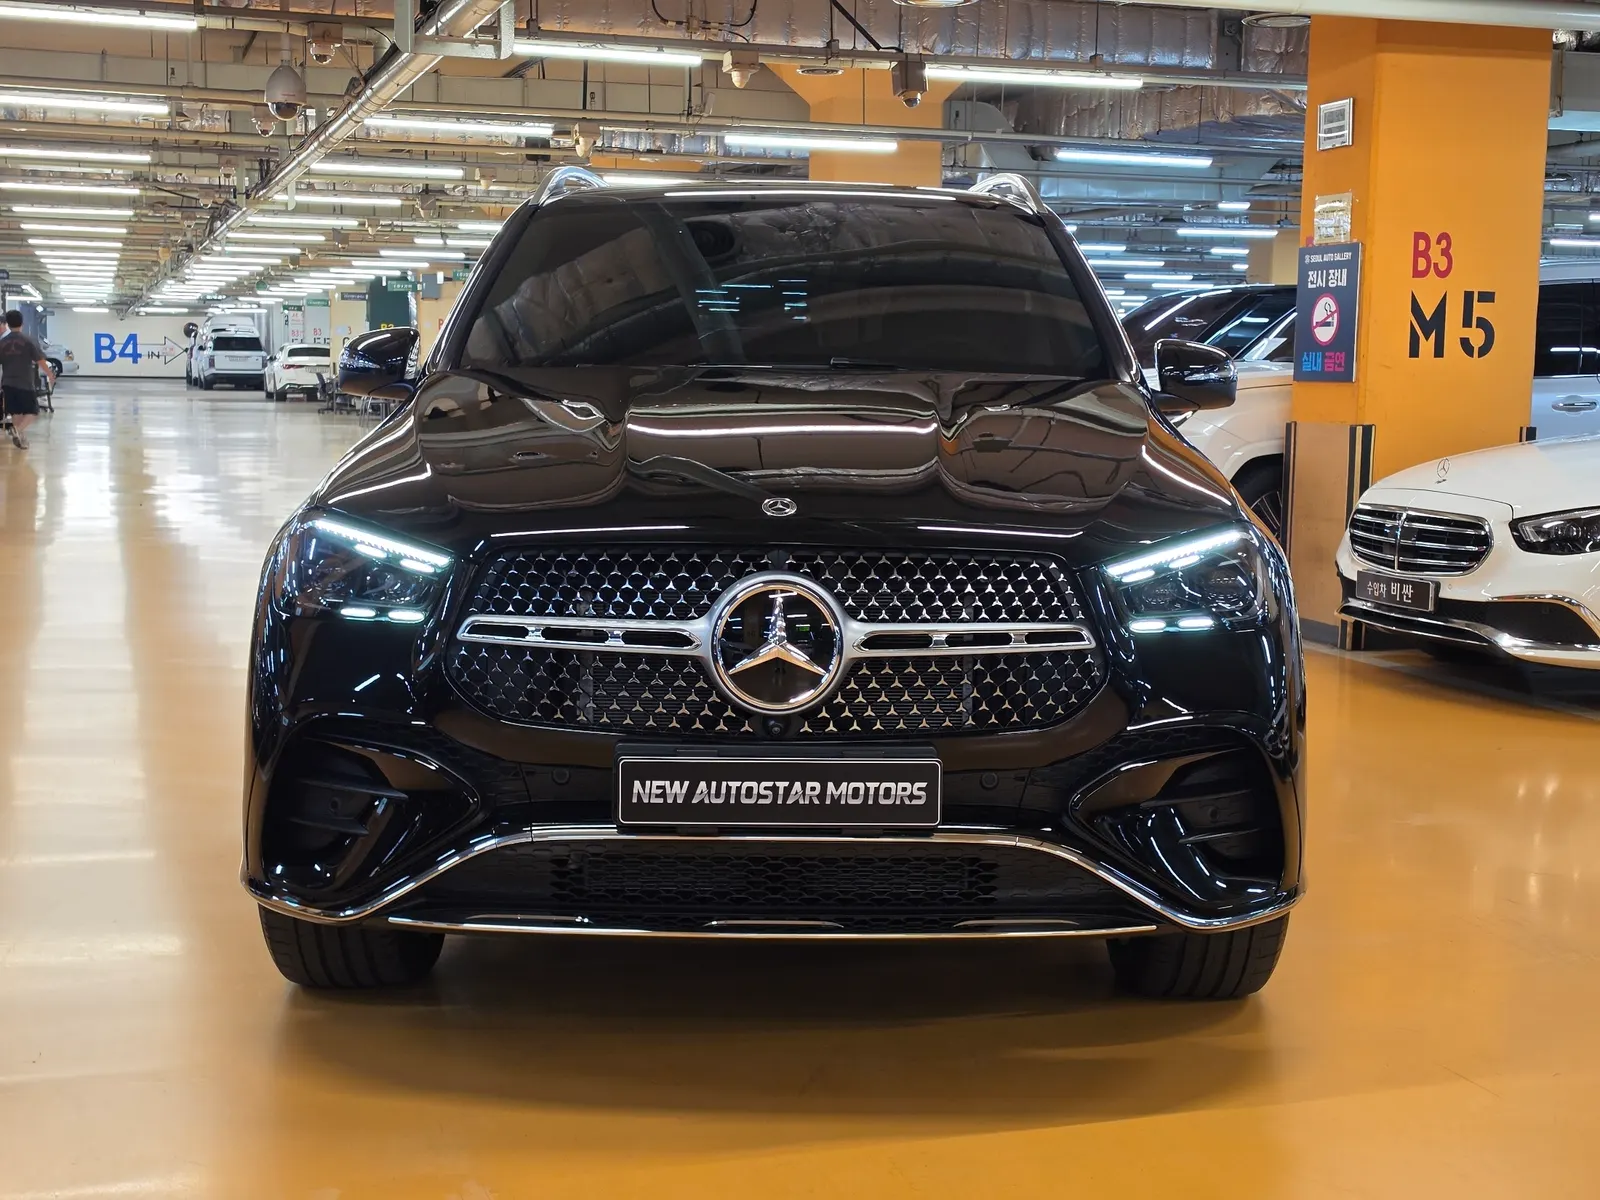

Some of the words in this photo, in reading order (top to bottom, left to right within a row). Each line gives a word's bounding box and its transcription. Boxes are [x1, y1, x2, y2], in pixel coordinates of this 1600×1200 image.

[1310, 254, 1323, 263] SEOUL
[1323, 253, 1334, 262] AUTO
[1334, 251, 1352, 261] GALLERY
[1411, 231, 1454, 279] B3
[1307, 269, 1326, 289] 전시
[94, 333, 142, 364] B4
[147, 351, 161, 360] IN
[1302, 351, 1322, 372] 실내
[1324, 351, 1346, 372] 금연
[1366, 581, 1387, 598] 수입차
[631, 780, 690, 804] NEW
[692, 780, 821, 805] AUTOSTAR
[825, 781, 928, 805] MOTORS
